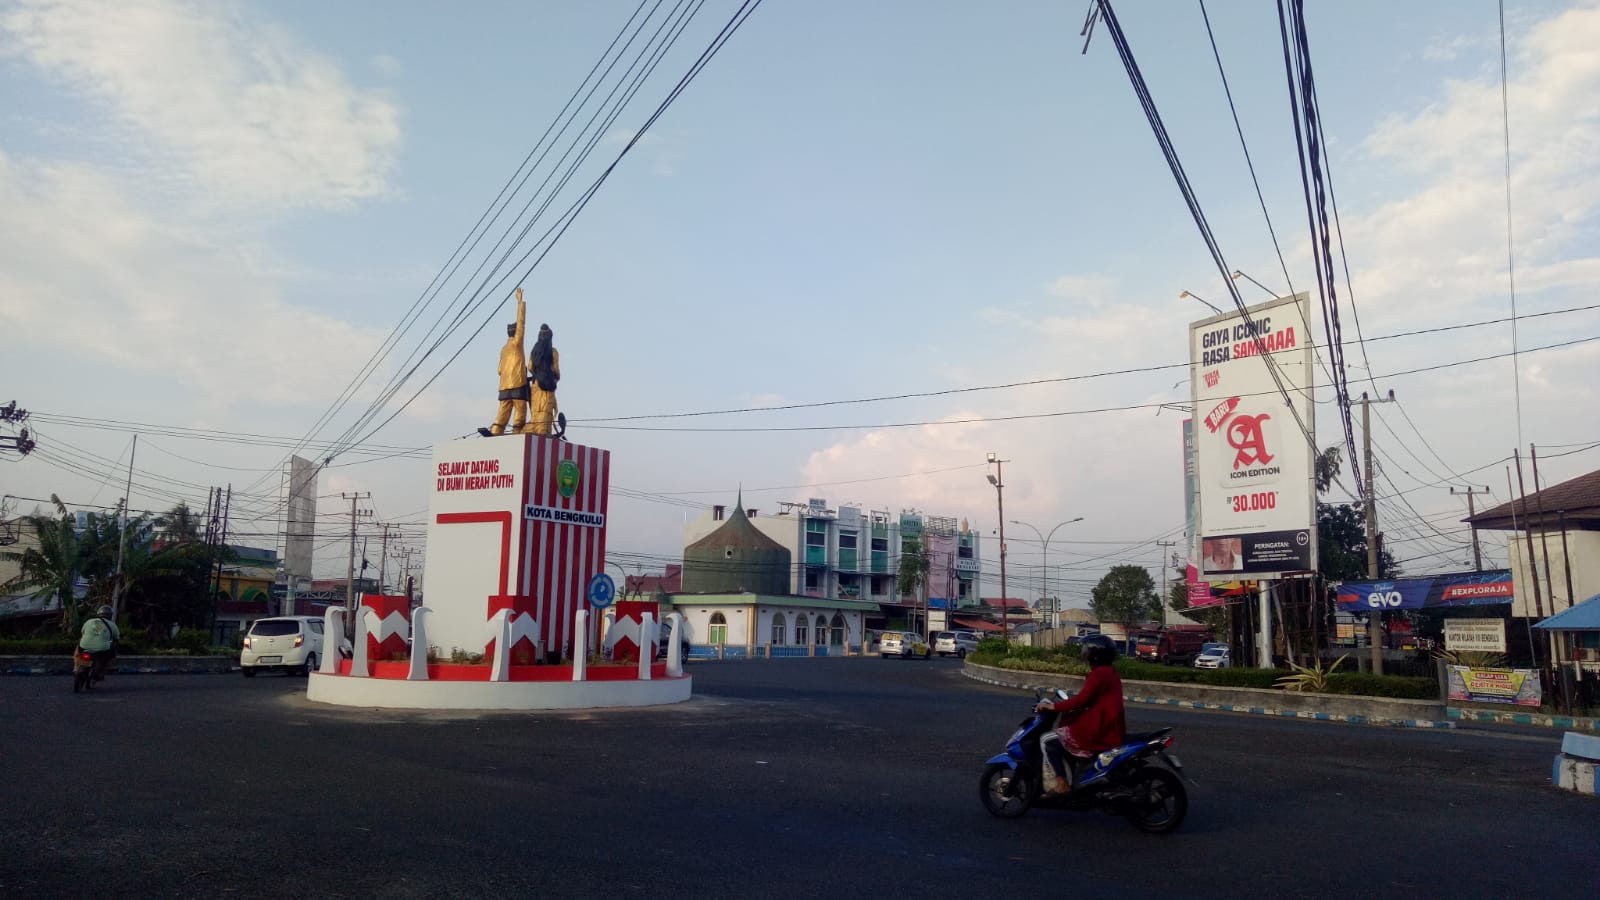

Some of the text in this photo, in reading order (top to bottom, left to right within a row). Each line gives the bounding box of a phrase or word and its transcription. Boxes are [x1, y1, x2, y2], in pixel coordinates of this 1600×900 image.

[1203, 317, 1271, 348] GAYA ICONIC
[1203, 347, 1230, 367] RASA
[1209, 401, 1229, 427] BARU
[438, 460, 499, 476] SELAMAT DATANG
[1230, 466, 1280, 479] ICON EDITION
[437, 474, 514, 491] DI BUMI MERAH PUTIH
[527, 506, 602, 525] KOTA BENGKULU
[1452, 583, 1508, 596] #EXPLORAJA
